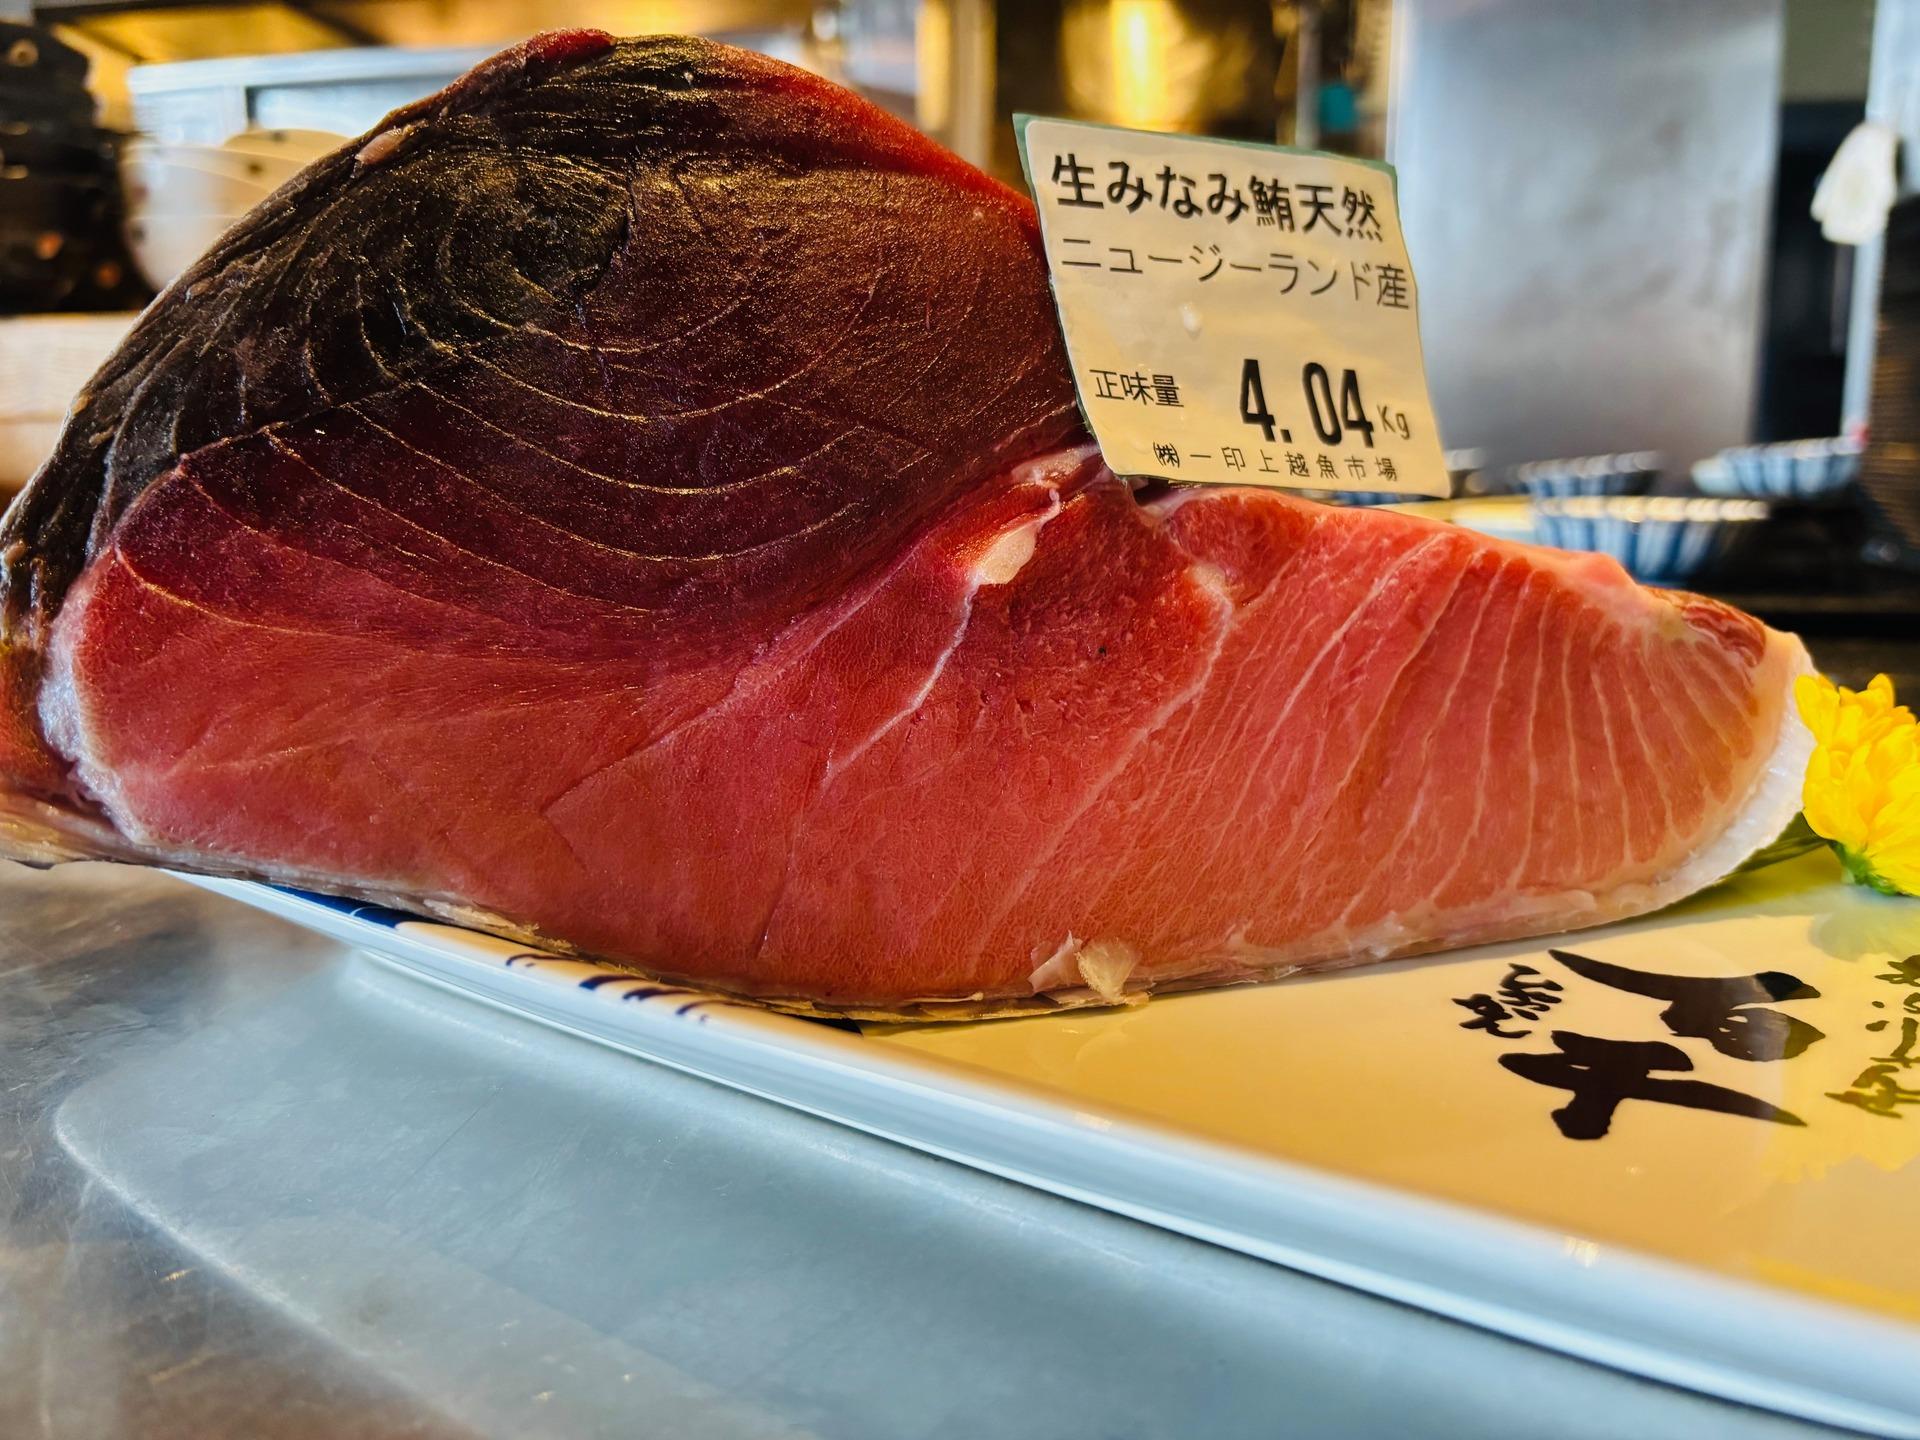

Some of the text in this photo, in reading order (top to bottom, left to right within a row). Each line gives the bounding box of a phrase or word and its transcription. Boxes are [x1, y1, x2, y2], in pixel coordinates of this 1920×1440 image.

[1051, 152, 1384, 243] 生みなみ鮪天然
[1061, 237, 1410, 310] ニュージーランド産
[1089, 358, 1411, 449] 正味量 4.04 Kg
